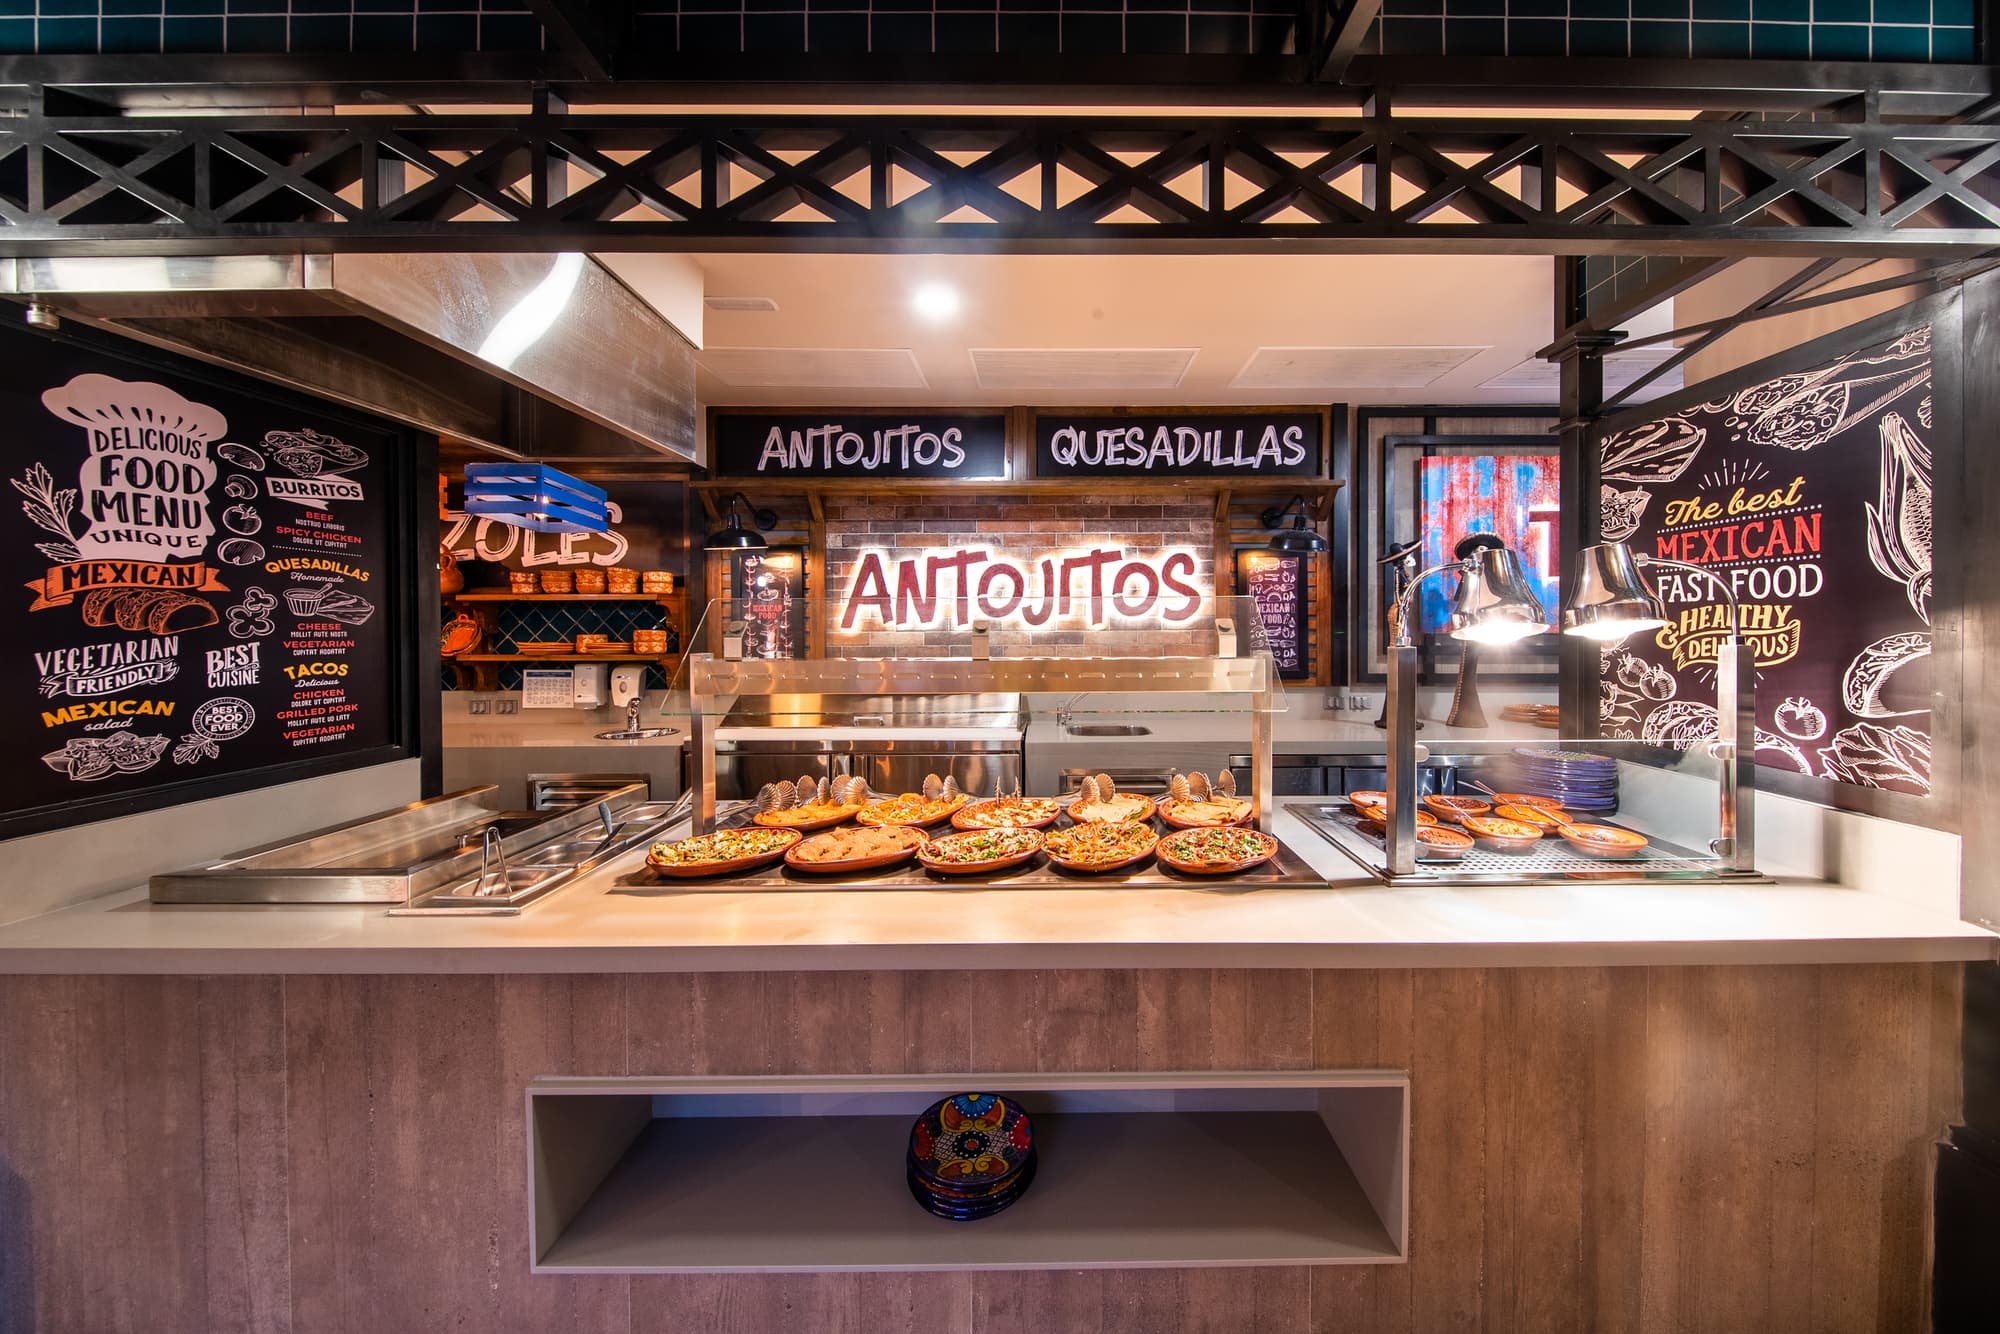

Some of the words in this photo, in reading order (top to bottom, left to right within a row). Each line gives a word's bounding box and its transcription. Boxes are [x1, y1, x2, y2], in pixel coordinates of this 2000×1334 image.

[94, 427, 202, 459] DELICIOUS
[757, 424, 965, 471] ANTOJITOS
[1051, 425, 1305, 469] QUESADILLAS
[100, 454, 204, 494] FOOD
[270, 480, 361, 498] BURRITOS
[91, 489, 201, 529] MENU
[1665, 496, 1723, 526] The
[1728, 476, 1806, 516] best
[305, 511, 334, 522] BEEF
[90, 530, 201, 548] UNIQUE
[276, 525, 311, 537] SPICY
[313, 531, 362, 544] CHICKEN
[1656, 513, 1823, 568] MEXICAN
[62, 562, 195, 591] MEXICAN
[265, 557, 370, 582] QUESADILLAS
[290, 571, 345, 583] Homemade
[840, 548, 1202, 629] ANTOJITOS
[1657, 571, 1722, 603] FAST
[1730, 563, 1825, 600] FOOD
[297, 623, 342, 631] CHEESE
[1262, 613, 1282, 625] FOOD
[283, 640, 355, 649] VEGETARIAN
[34, 636, 179, 677] VEGETARIAN
[205, 641, 261, 674] BEST
[76, 666, 156, 694] FRIENDLY
[207, 669, 261, 689] CUISINE
[283, 662, 349, 680] TACOS
[294, 679, 340, 688] Delicious
[293, 689, 345, 700] CHICKEN
[41, 700, 175, 729] MEXICAN
[212, 705, 239, 715] BEST
[276, 707, 326, 720] GRILLED
[328, 704, 359, 714] PORK
[83, 716, 134, 732] salad
[205, 714, 243, 726] FOOD
[210, 722, 238, 732] EVER
[282, 723, 355, 740] VEGETARIAN
